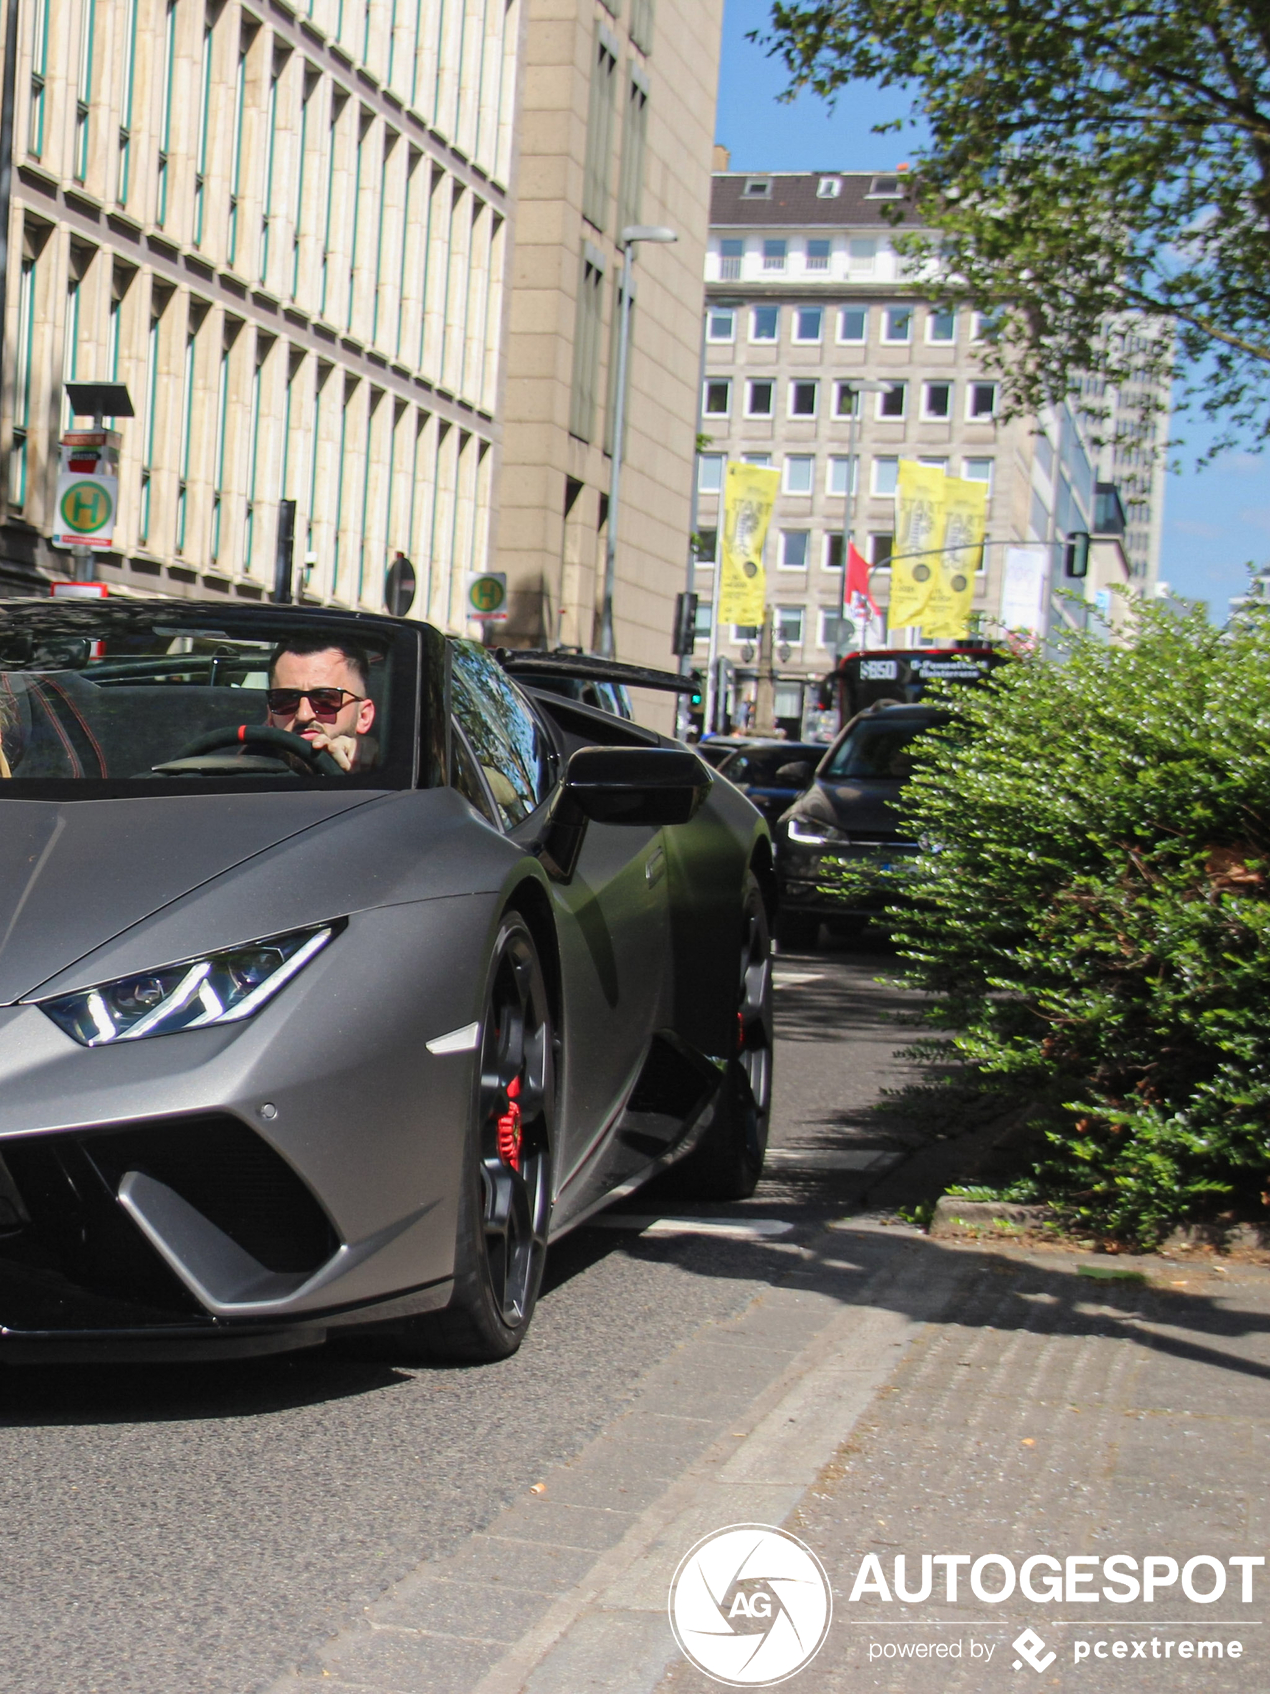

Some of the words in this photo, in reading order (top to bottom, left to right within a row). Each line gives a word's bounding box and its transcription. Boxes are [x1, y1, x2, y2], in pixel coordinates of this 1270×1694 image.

[74, 492, 100, 522] H
[945, 511, 984, 528] TART
[479, 585, 495, 604] H
